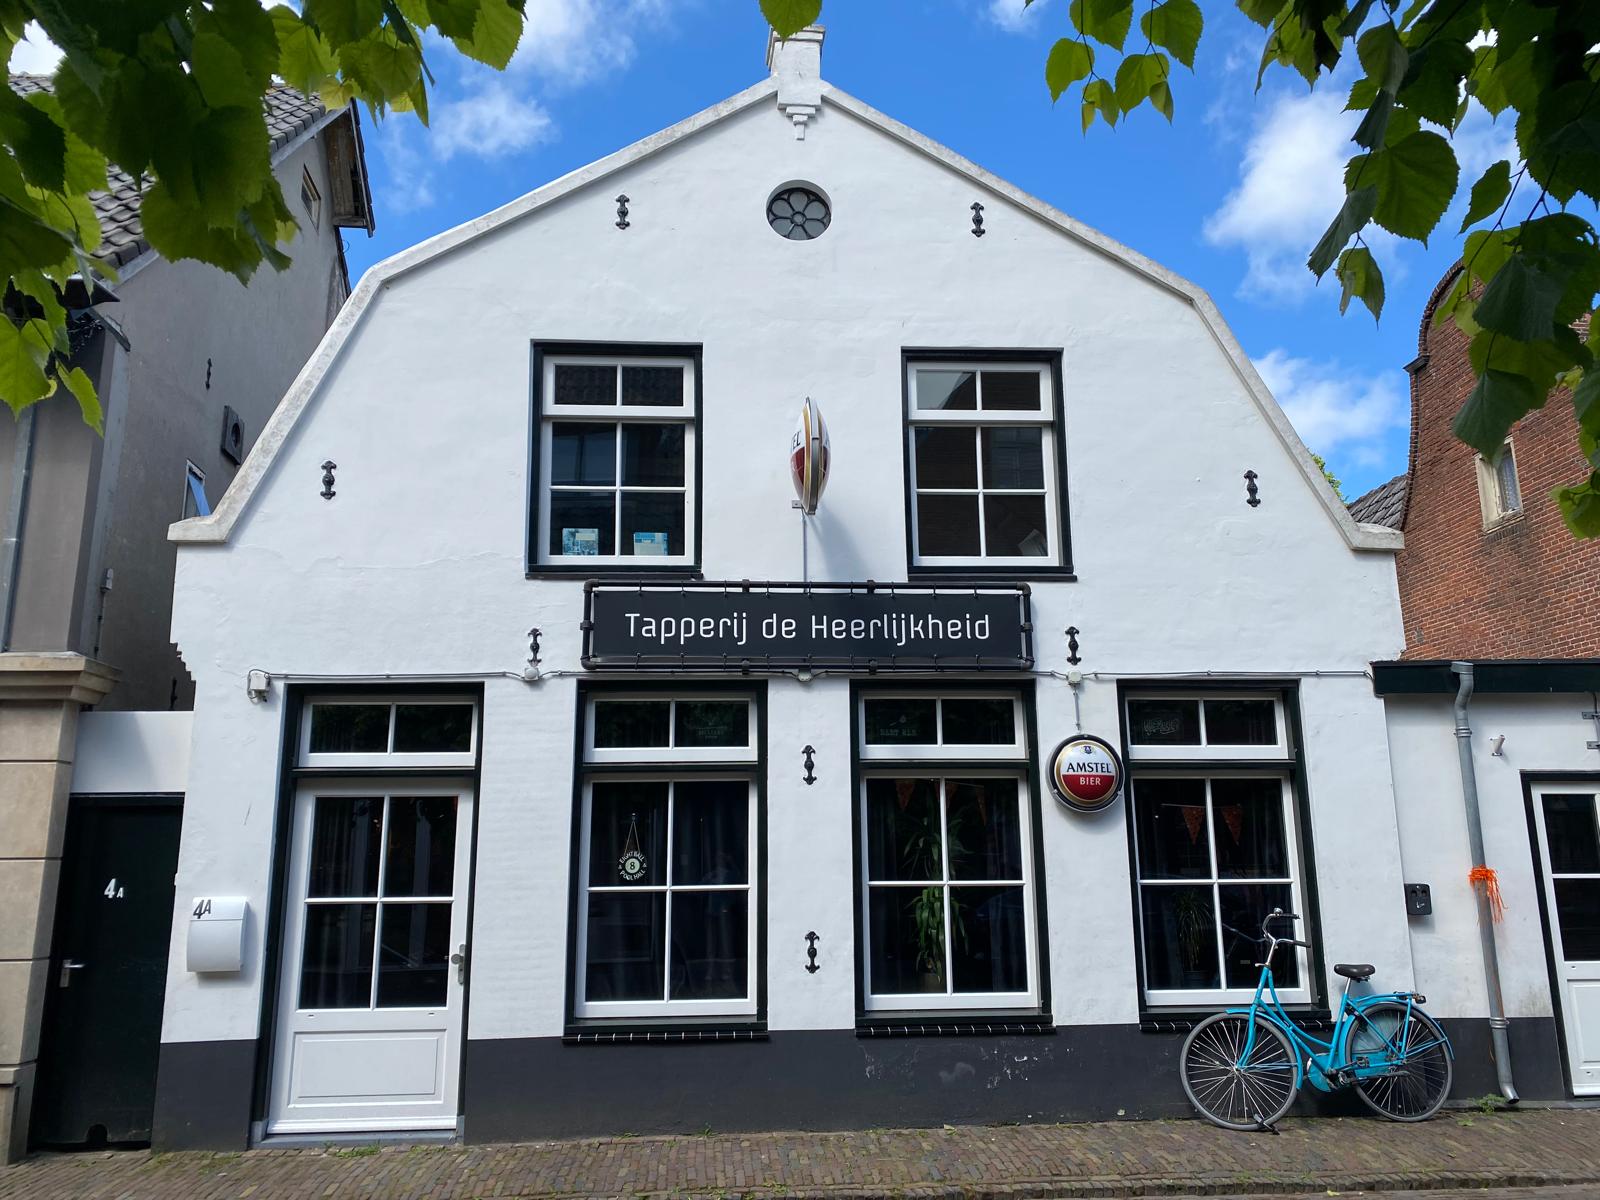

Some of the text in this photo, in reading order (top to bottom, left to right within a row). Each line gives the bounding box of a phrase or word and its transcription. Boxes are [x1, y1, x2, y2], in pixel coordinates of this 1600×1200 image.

[625, 612, 990, 647] Tapperij de Heerlijkheid
[1066, 762, 1112, 773] AMSTEL
[1079, 777, 1101, 785] BIER
[629, 861, 636, 870] 8
[619, 869, 646, 881] POOL HALL
[192, 899, 212, 919] 4A
